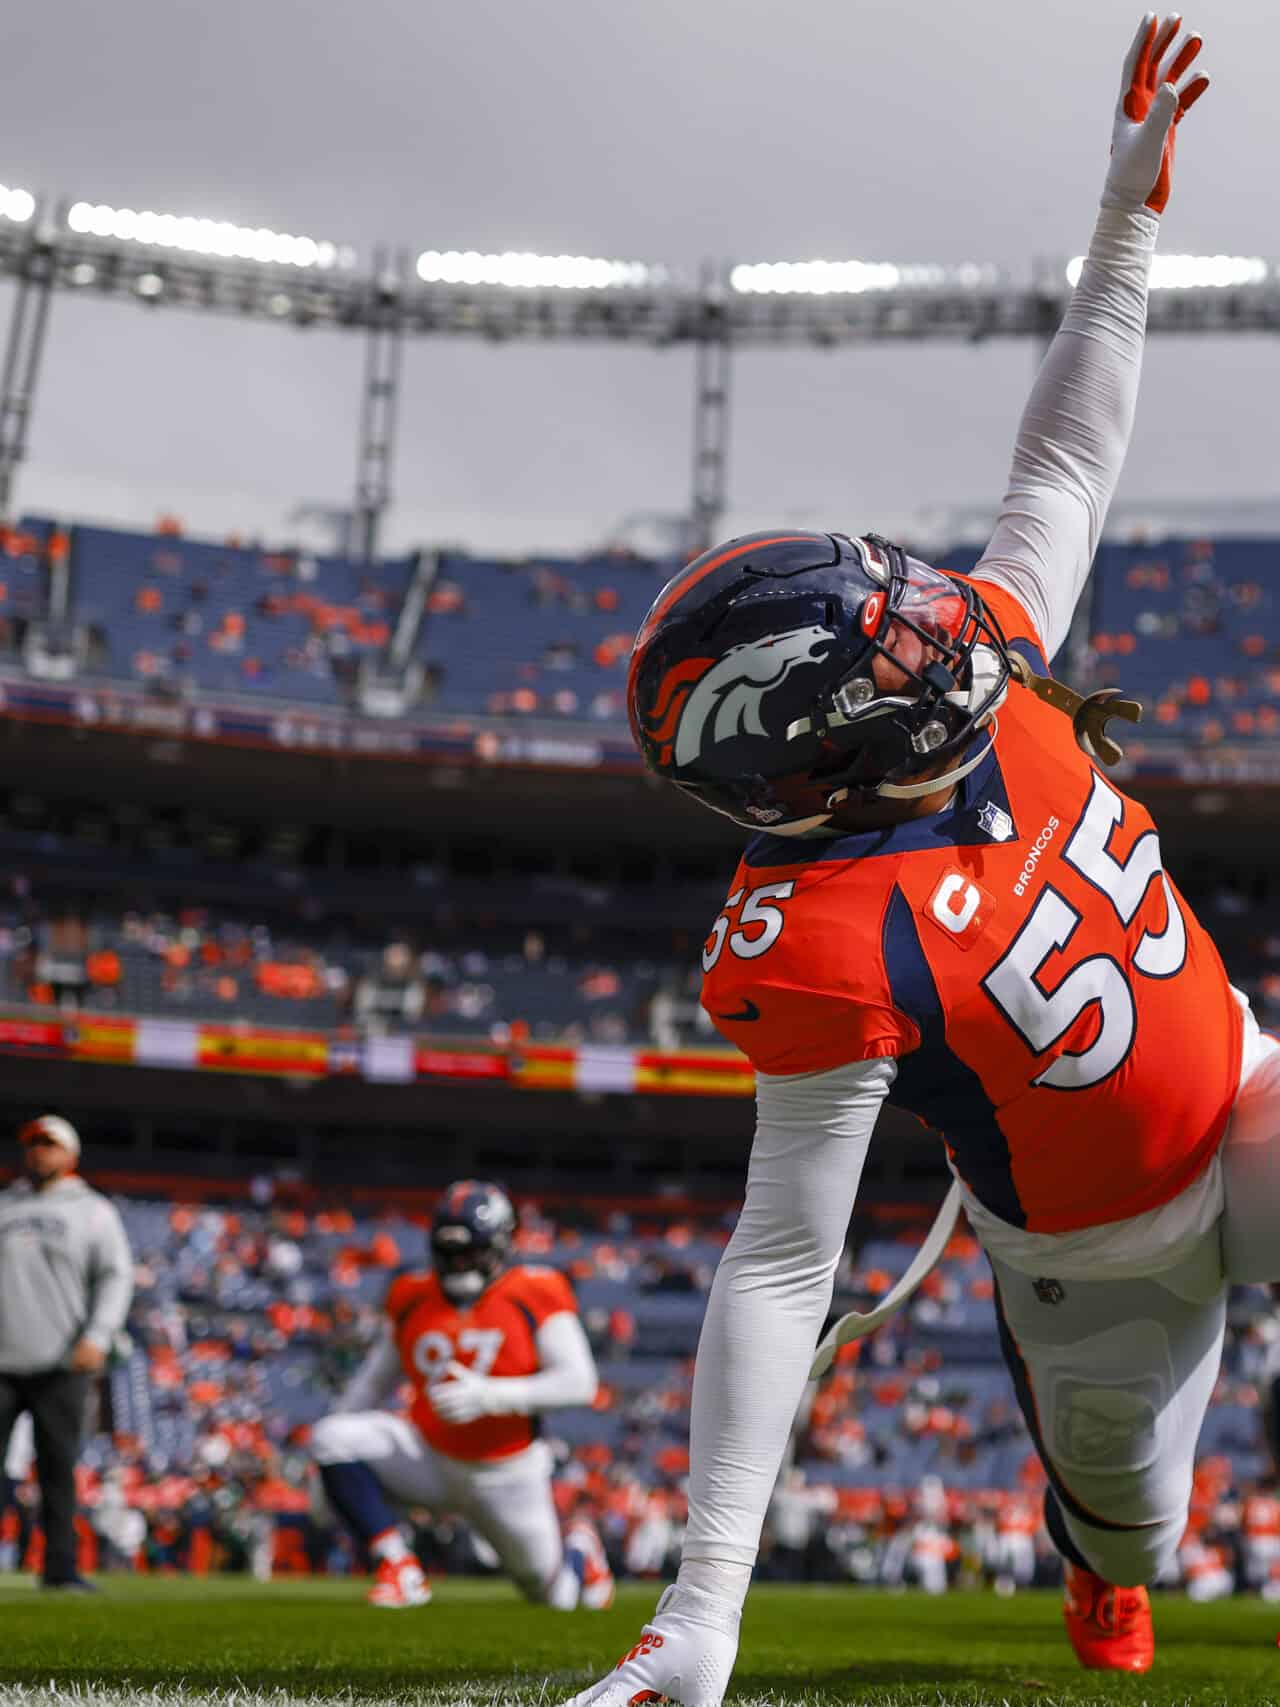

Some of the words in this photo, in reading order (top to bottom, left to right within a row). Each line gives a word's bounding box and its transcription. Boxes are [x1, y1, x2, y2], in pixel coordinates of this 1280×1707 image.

[1013, 816, 1059, 897] BRONCOS
[933, 874, 981, 934] C
[981, 766, 1188, 1091] 55
